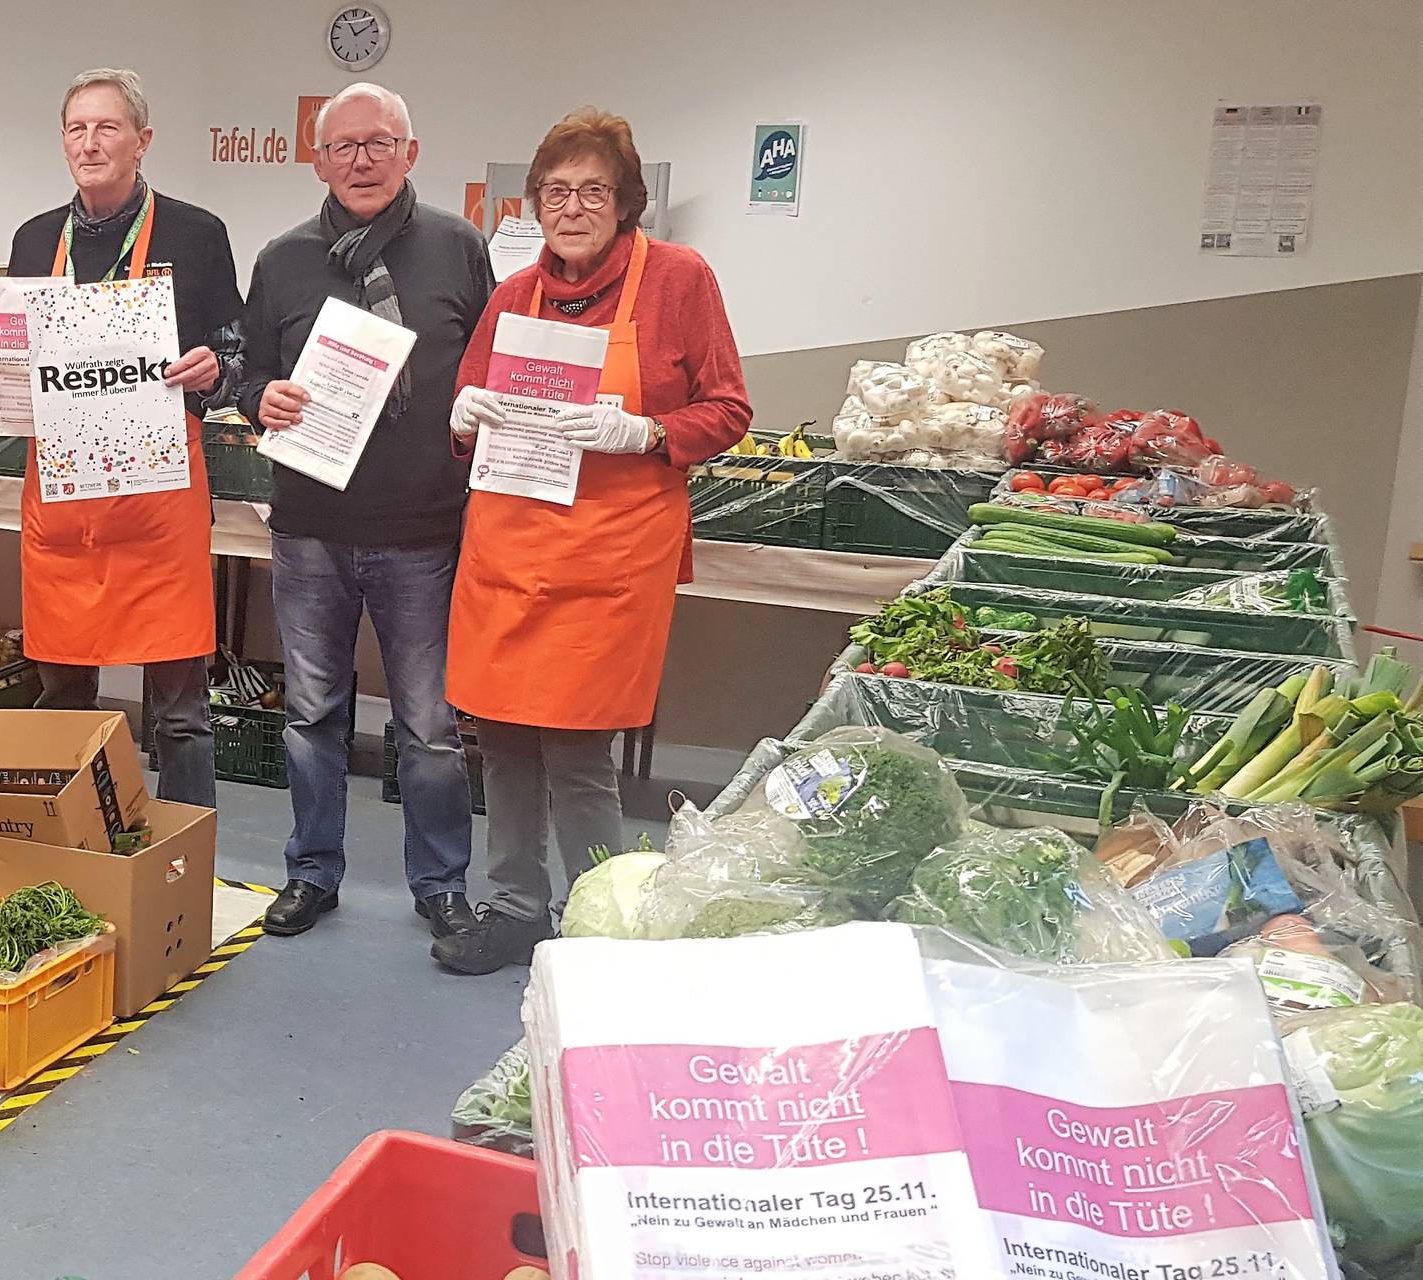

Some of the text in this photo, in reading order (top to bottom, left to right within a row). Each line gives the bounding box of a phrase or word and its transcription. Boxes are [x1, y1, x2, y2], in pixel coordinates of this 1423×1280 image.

[209, 127, 288, 163] Tafel.de
[760, 137, 796, 168] AHA
[0, 340, 25, 348] in die
[38, 356, 173, 393] Respekt
[65, 357, 125, 371] Wülfrath zeigt
[510, 371, 574, 388] kommt nicht
[525, 361, 565, 375] Gewalt
[72, 389, 100, 399] immer
[109, 385, 137, 396] überall
[509, 384, 520, 395] in
[521, 386, 538, 397] die
[539, 388, 565, 401] Tüte
[688, 1054, 812, 1086] Gewalt
[648, 1087, 865, 1123] kommt nicht
[1046, 1107, 1158, 1149] Gewalt
[661, 1127, 869, 1164] in die Tüte !
[1016, 1137, 1212, 1189] kommt nicht
[627, 1181, 936, 1214] Internationaler Tag 25.11.
[1028, 1183, 1217, 1233] in die Tüte !
[674, 1218, 690, 1228] zu
[694, 1216, 745, 1229] Gewalt
[747, 1220, 765, 1230] an
[769, 1215, 837, 1229] Mädchen
[841, 1210, 870, 1223] und
[873, 1206, 927, 1221] Frauen
[635, 1251, 672, 1269] Stop
[744, 1254, 801, 1272] again
[1003, 1237, 1150, 1280] Internationaler
[1210, 1251, 1285, 1278] 25.11.
[1049, 1269, 1064, 1280] zu
